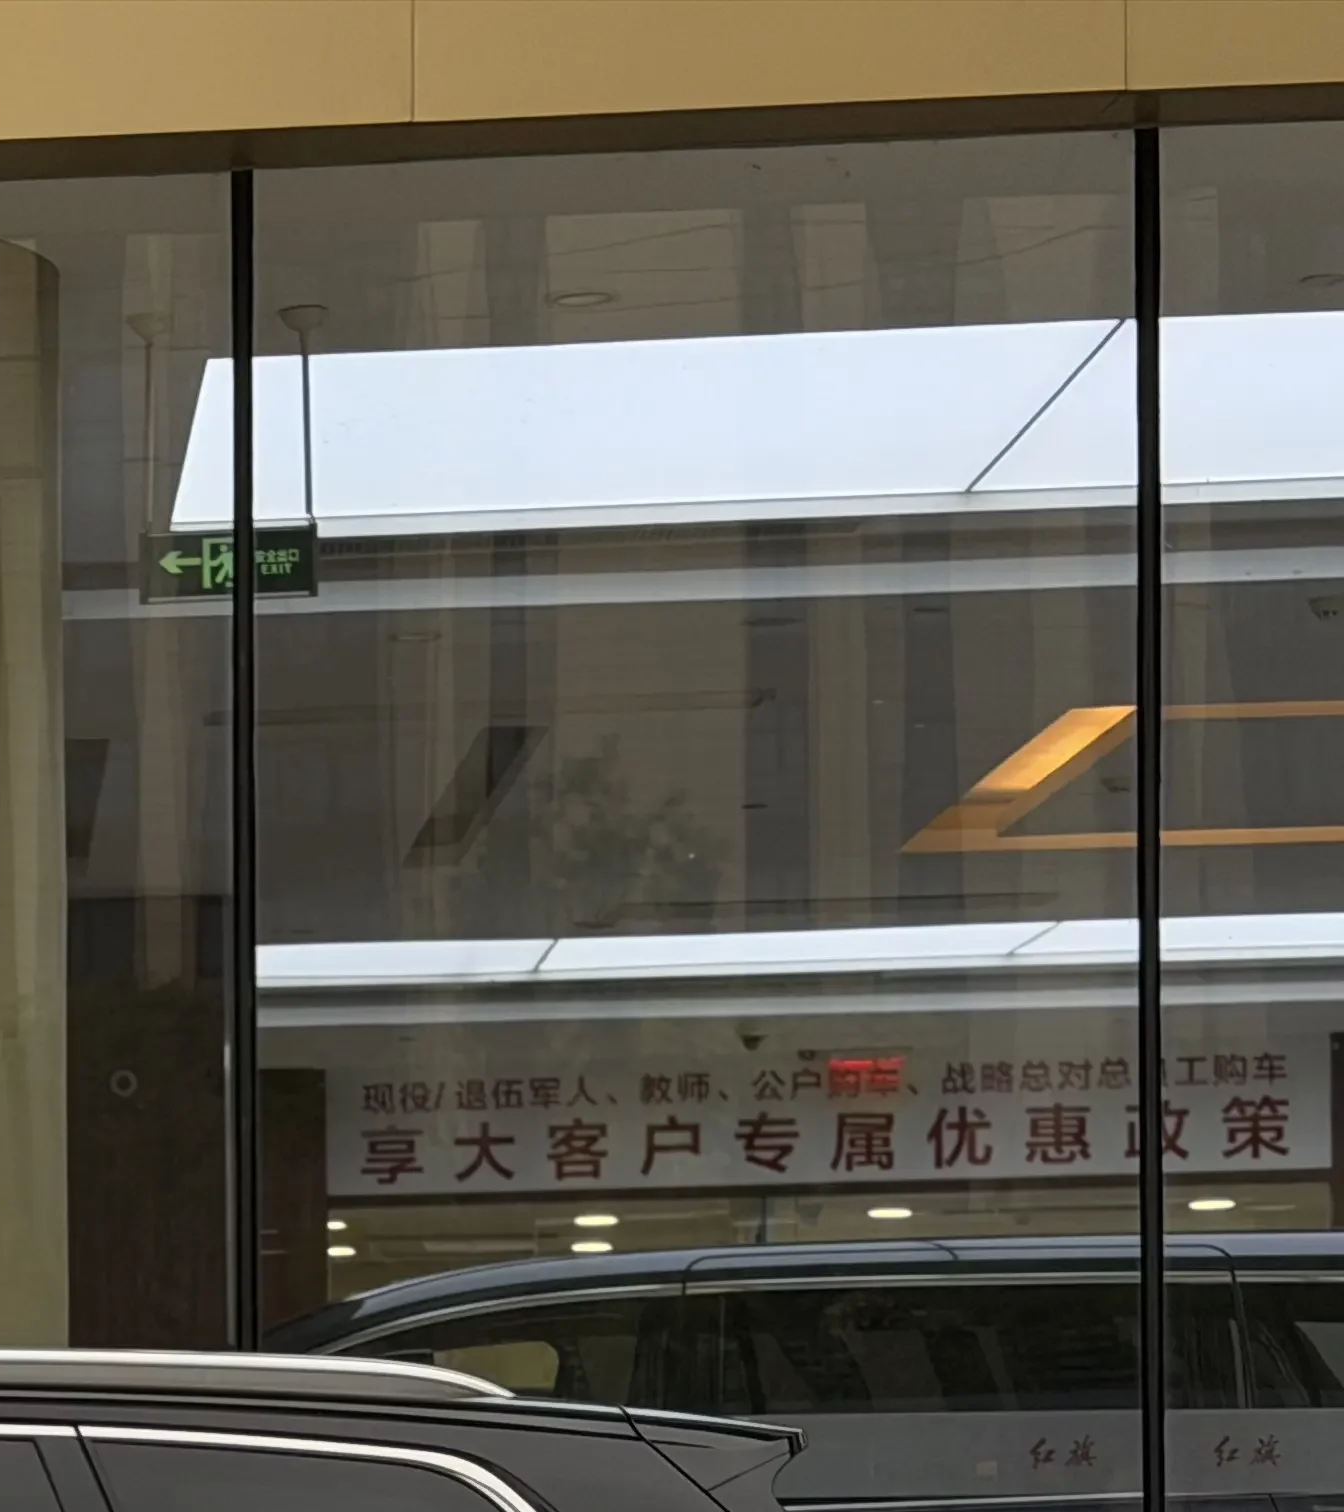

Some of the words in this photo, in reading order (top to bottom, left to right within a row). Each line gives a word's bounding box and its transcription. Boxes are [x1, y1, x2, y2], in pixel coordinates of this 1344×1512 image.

[360, 1096, 1290, 1184] 享大客户专属优惠政策
[1029, 1434, 1098, 1470] 红旗
[1214, 1433, 1282, 1467] 红旗
